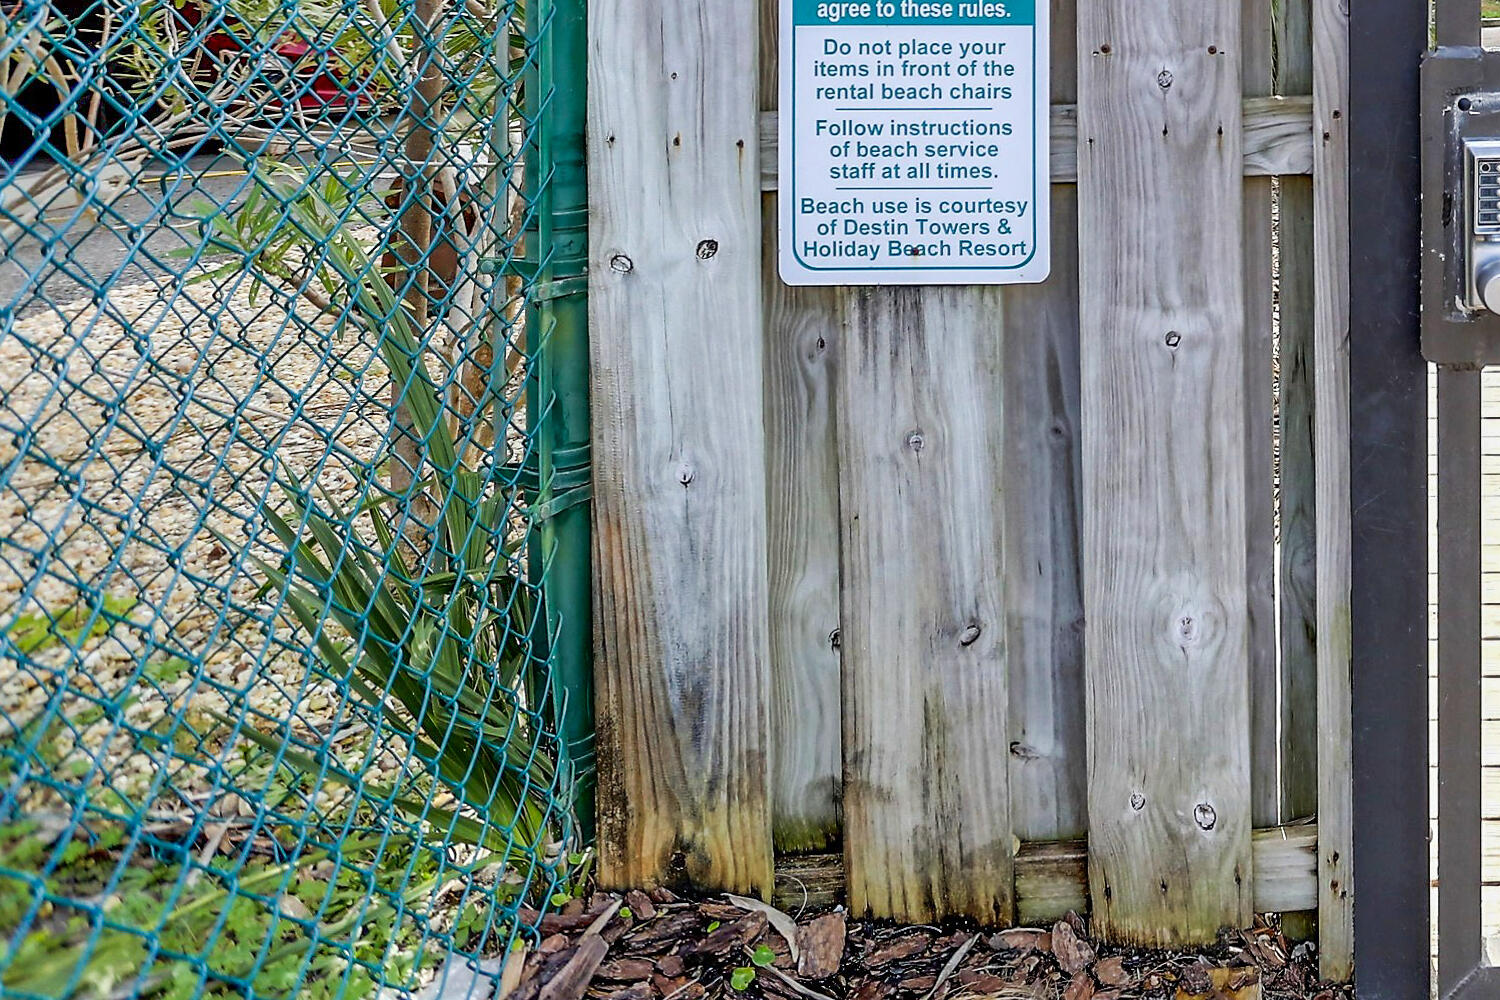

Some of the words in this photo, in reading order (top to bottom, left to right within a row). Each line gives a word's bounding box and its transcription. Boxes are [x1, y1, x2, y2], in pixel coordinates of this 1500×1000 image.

[817, 2, 871, 23] agree
[875, 0, 896, 18] to
[823, 38, 852, 56] Do
[858, 39, 892, 56] not
[898, 38, 953, 59] place
[959, 42, 1006, 59] your
[814, 60, 870, 77] items
[877, 60, 894, 77] in
[901, 59, 951, 77] front
[957, 59, 978, 77] of
[983, 60, 1015, 77] the
[816, 83, 874, 100] rental
[881, 83, 943, 100] beach
[949, 82, 1013, 100] chairs
[815, 119, 884, 136] Follow
[890, 119, 1013, 136] instructions
[829, 140, 851, 158] of
[856, 140, 918, 158] beach
[924, 140, 999, 158] service
[829, 162, 876, 180] staff
[881, 163, 901, 179] at
[906, 162, 930, 179] all
[936, 162, 998, 179] times.
[801, 197, 864, 215] Beach
[872, 201, 908, 214] use
[915, 197, 932, 214] is
[939, 198, 1028, 217] courtesy
[816, 218, 838, 236] of
[844, 218, 909, 236] Destin
[915, 218, 990, 235] Towers
[997, 218, 1012, 235] &
[803, 240, 881, 261] Holiday
[888, 239, 951, 257] Beach
[959, 239, 1027, 257] Resort
